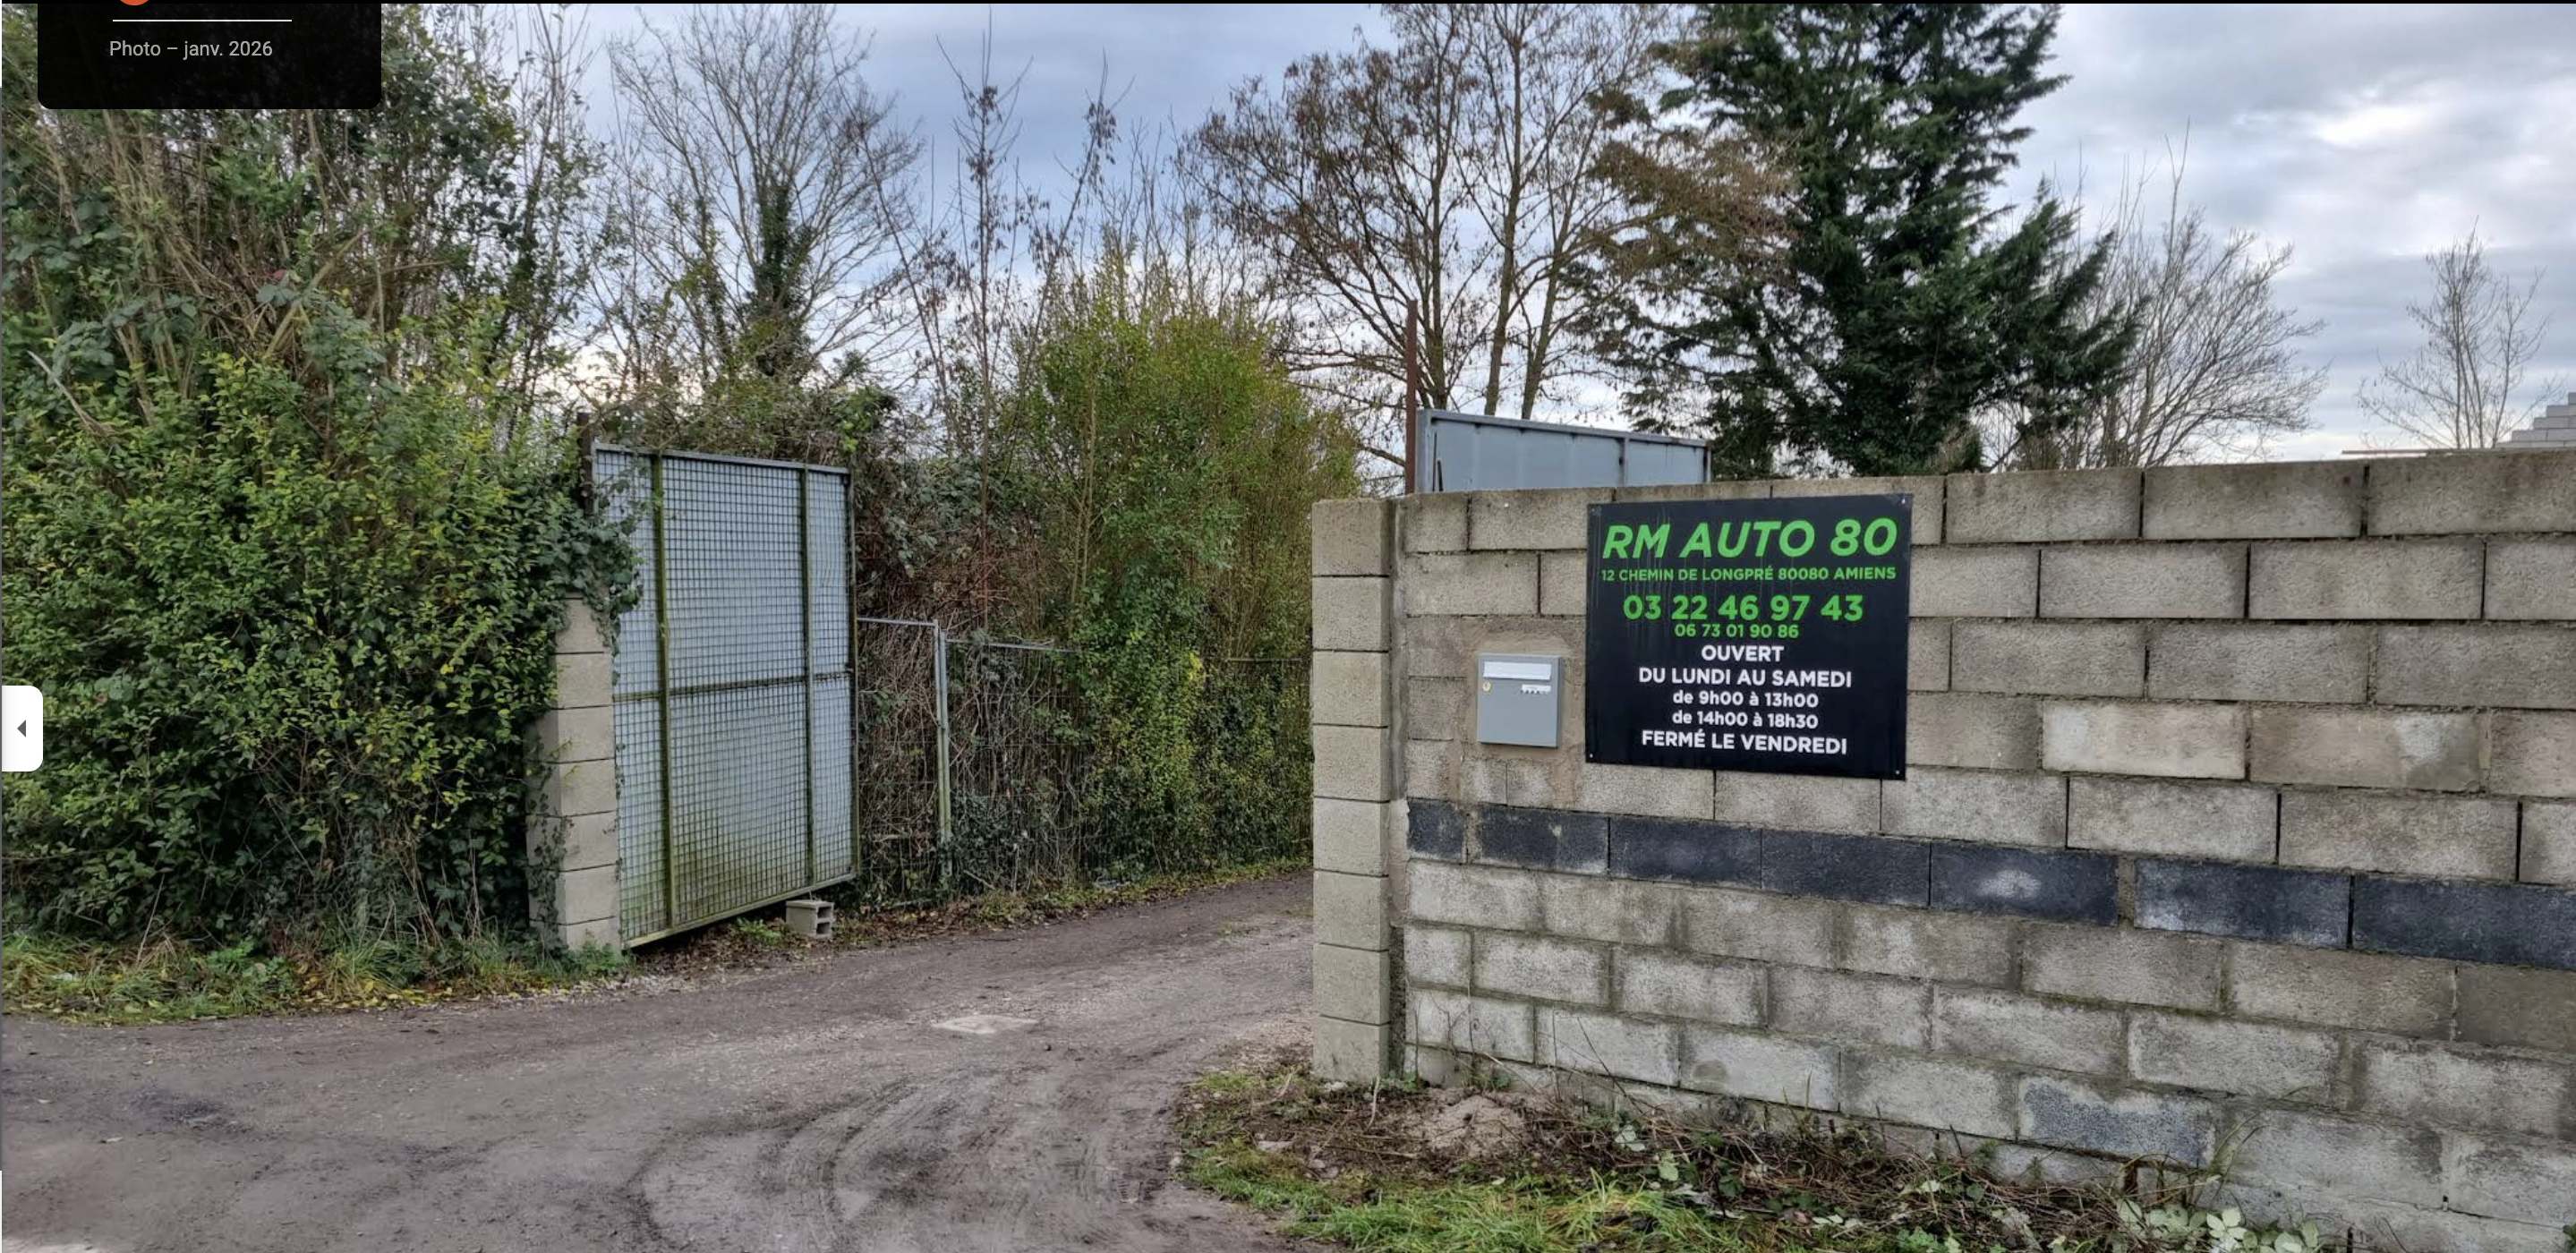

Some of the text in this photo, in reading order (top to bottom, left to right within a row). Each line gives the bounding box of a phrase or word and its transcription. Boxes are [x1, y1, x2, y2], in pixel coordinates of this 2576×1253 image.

[1602, 516, 1898, 559] RM AUTO 80
[1601, 565, 1897, 582] 12 CHEMIN DE LONGPRÉ 80080 AMIENS
[1623, 594, 1864, 622] 03 22 46 97 43
[1674, 623, 1799, 639] 06 73 01 90 86
[1701, 644, 1785, 662] OUVERT
[1638, 666, 1852, 688] DU LUNDI AU SAMEDI
[1672, 688, 1820, 709] de 9h00 à 13h00
[1671, 709, 1819, 729] de 14h00 à 18h30
[1642, 728, 1847, 755] FERMÉ LE VENDREDI
